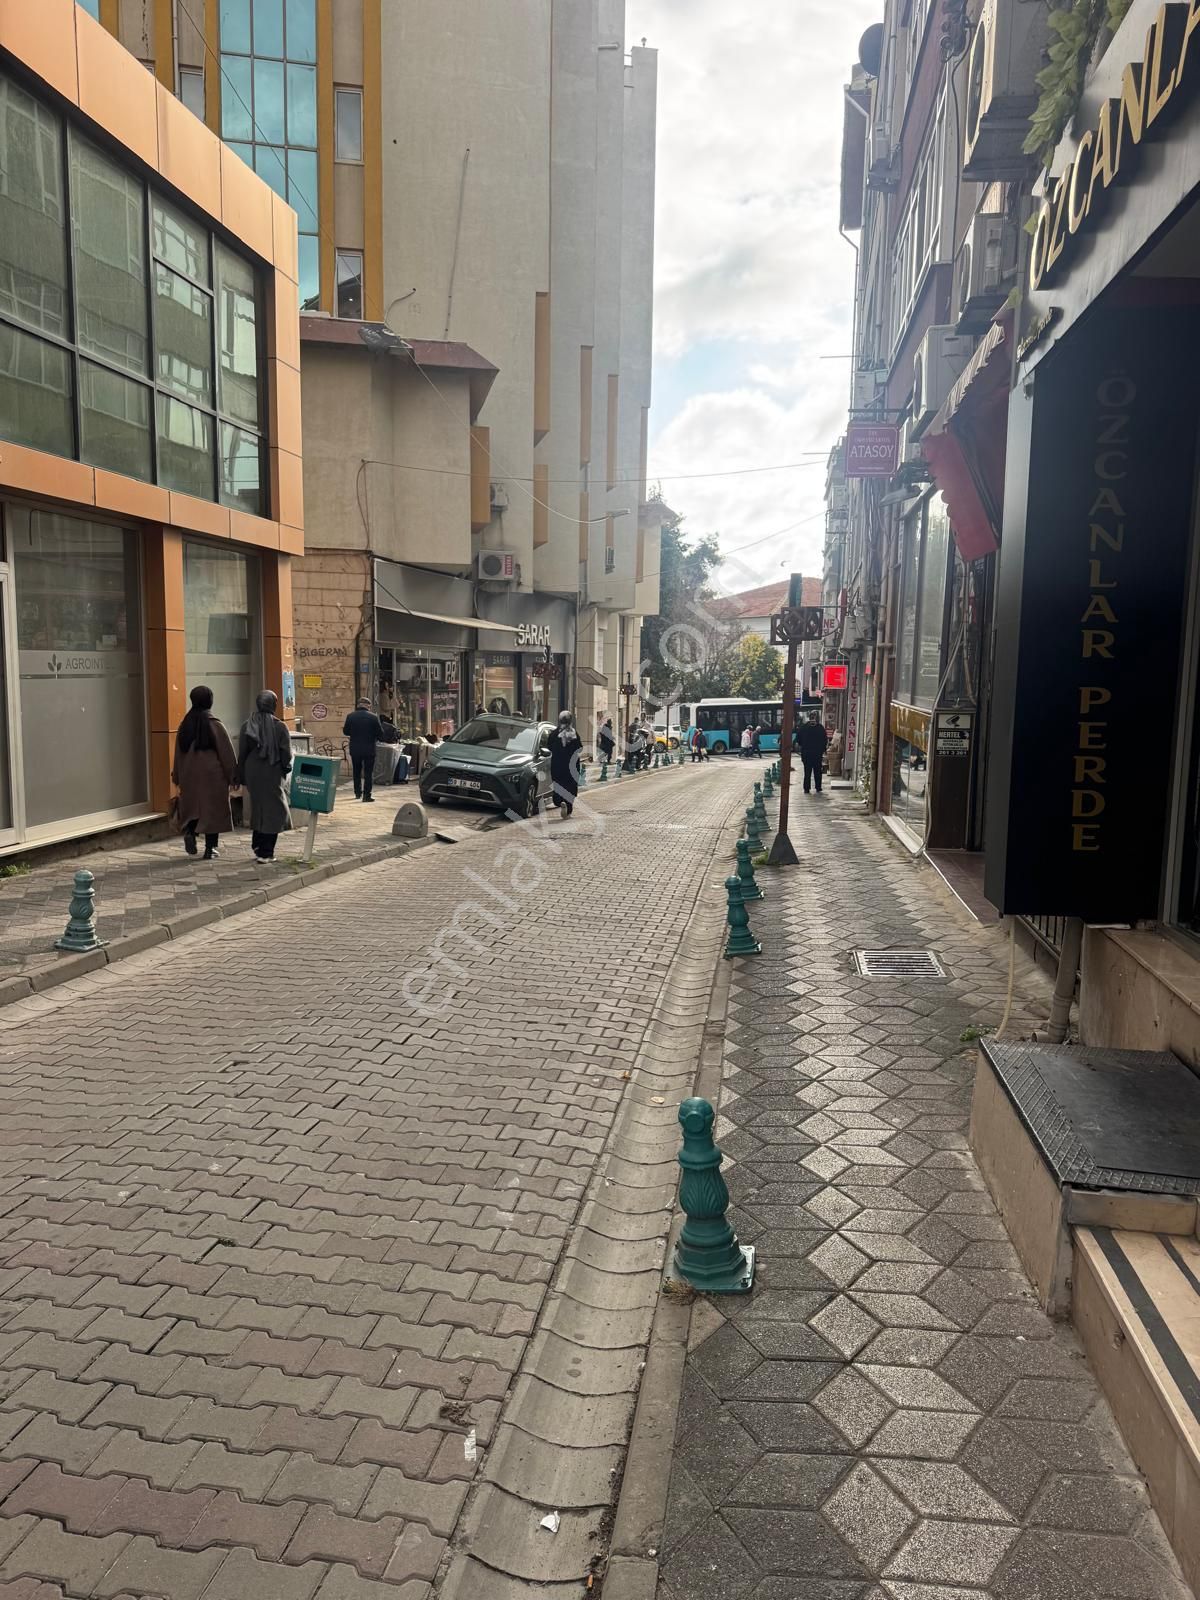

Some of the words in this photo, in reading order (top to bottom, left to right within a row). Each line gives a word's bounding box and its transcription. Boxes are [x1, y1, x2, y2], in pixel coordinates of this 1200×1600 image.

[850, 445, 894, 457] ATASOY
[1081, 369, 1137, 659] ÖZCANLAR
[518, 623, 550, 646] SARAR
[65, 656, 114, 670] AGROINT
[1072, 686, 1112, 851] PERDE
